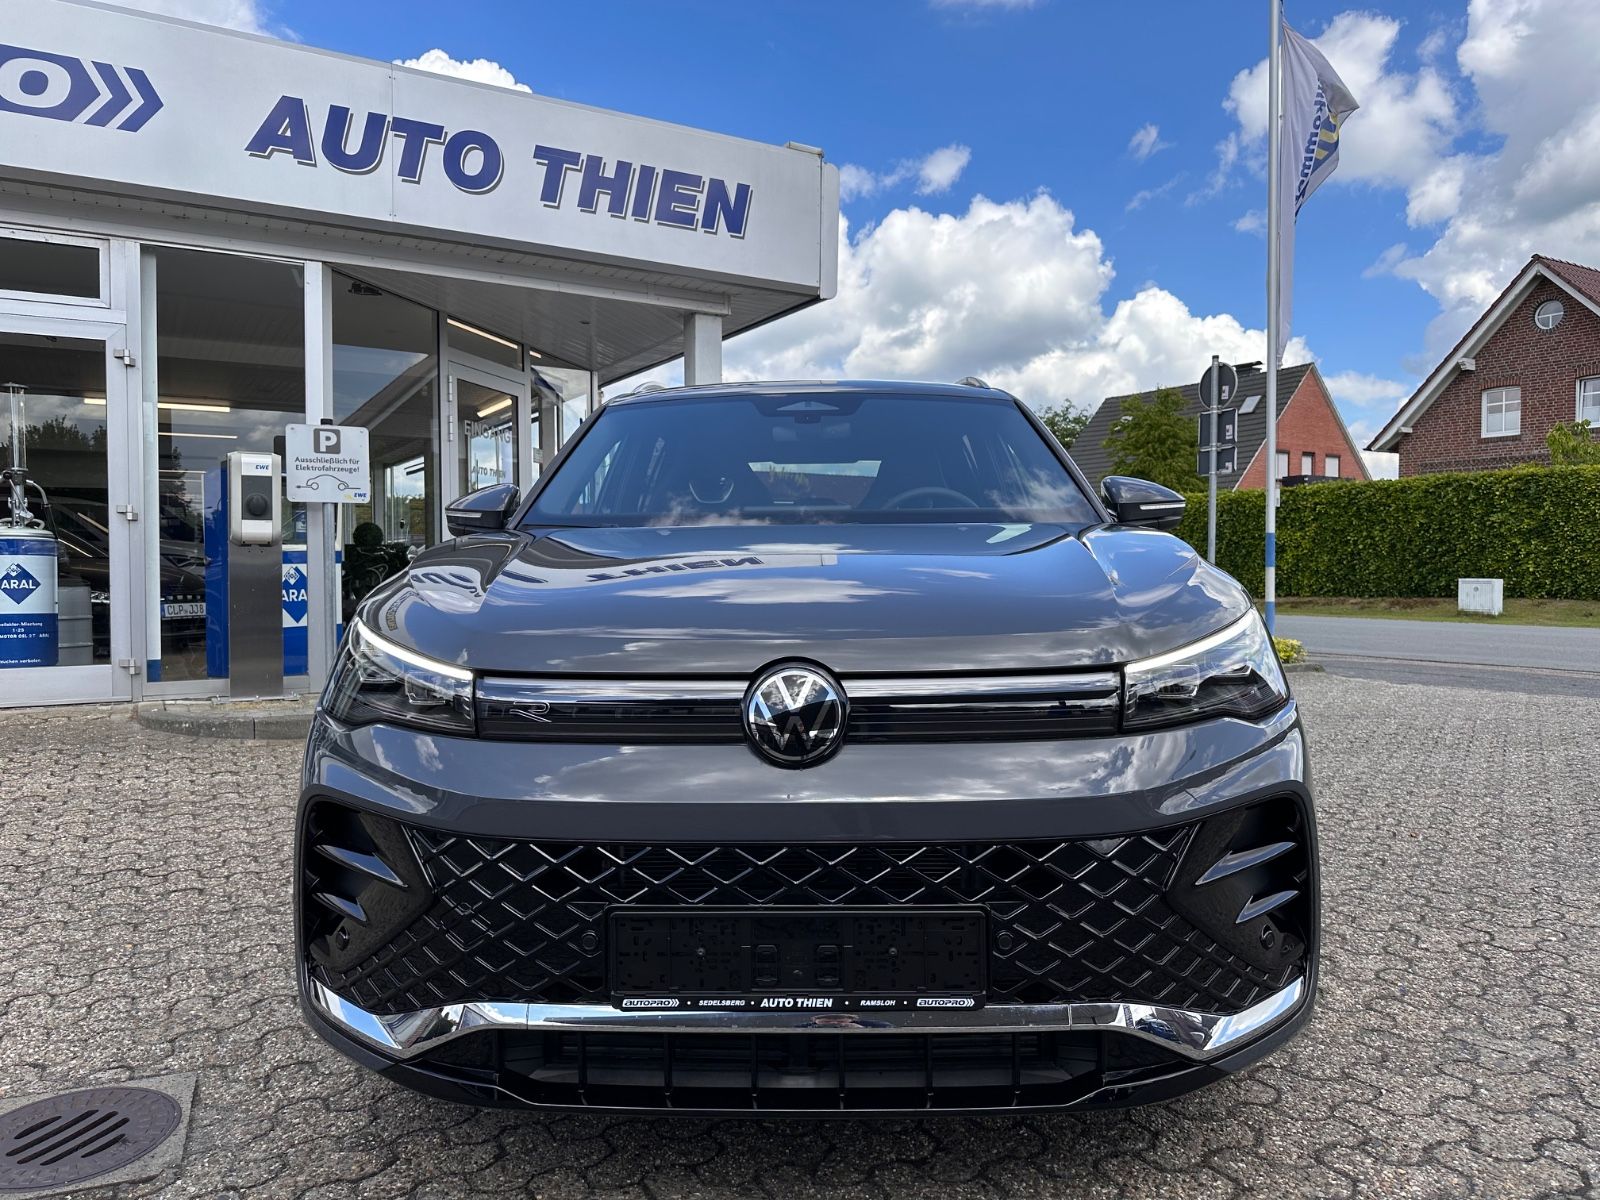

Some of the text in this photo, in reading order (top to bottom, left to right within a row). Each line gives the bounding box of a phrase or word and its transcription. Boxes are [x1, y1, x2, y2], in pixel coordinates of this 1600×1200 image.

[244, 94, 752, 239] AUTO THIEN
[464, 420, 511, 443] EINGANG
[320, 431, 338, 452] P
[295, 457, 348, 465] Ausschließlich
[295, 464, 360, 474] Elektrofahrzeuge!
[471, 466, 489, 476] AUTO
[1, 579, 37, 589] ARAL
[282, 589, 307, 602] ARA
[167, 604, 184, 615] CLP
[760, 998, 795, 1008] AUTO
[796, 998, 833, 1008] THIEN
